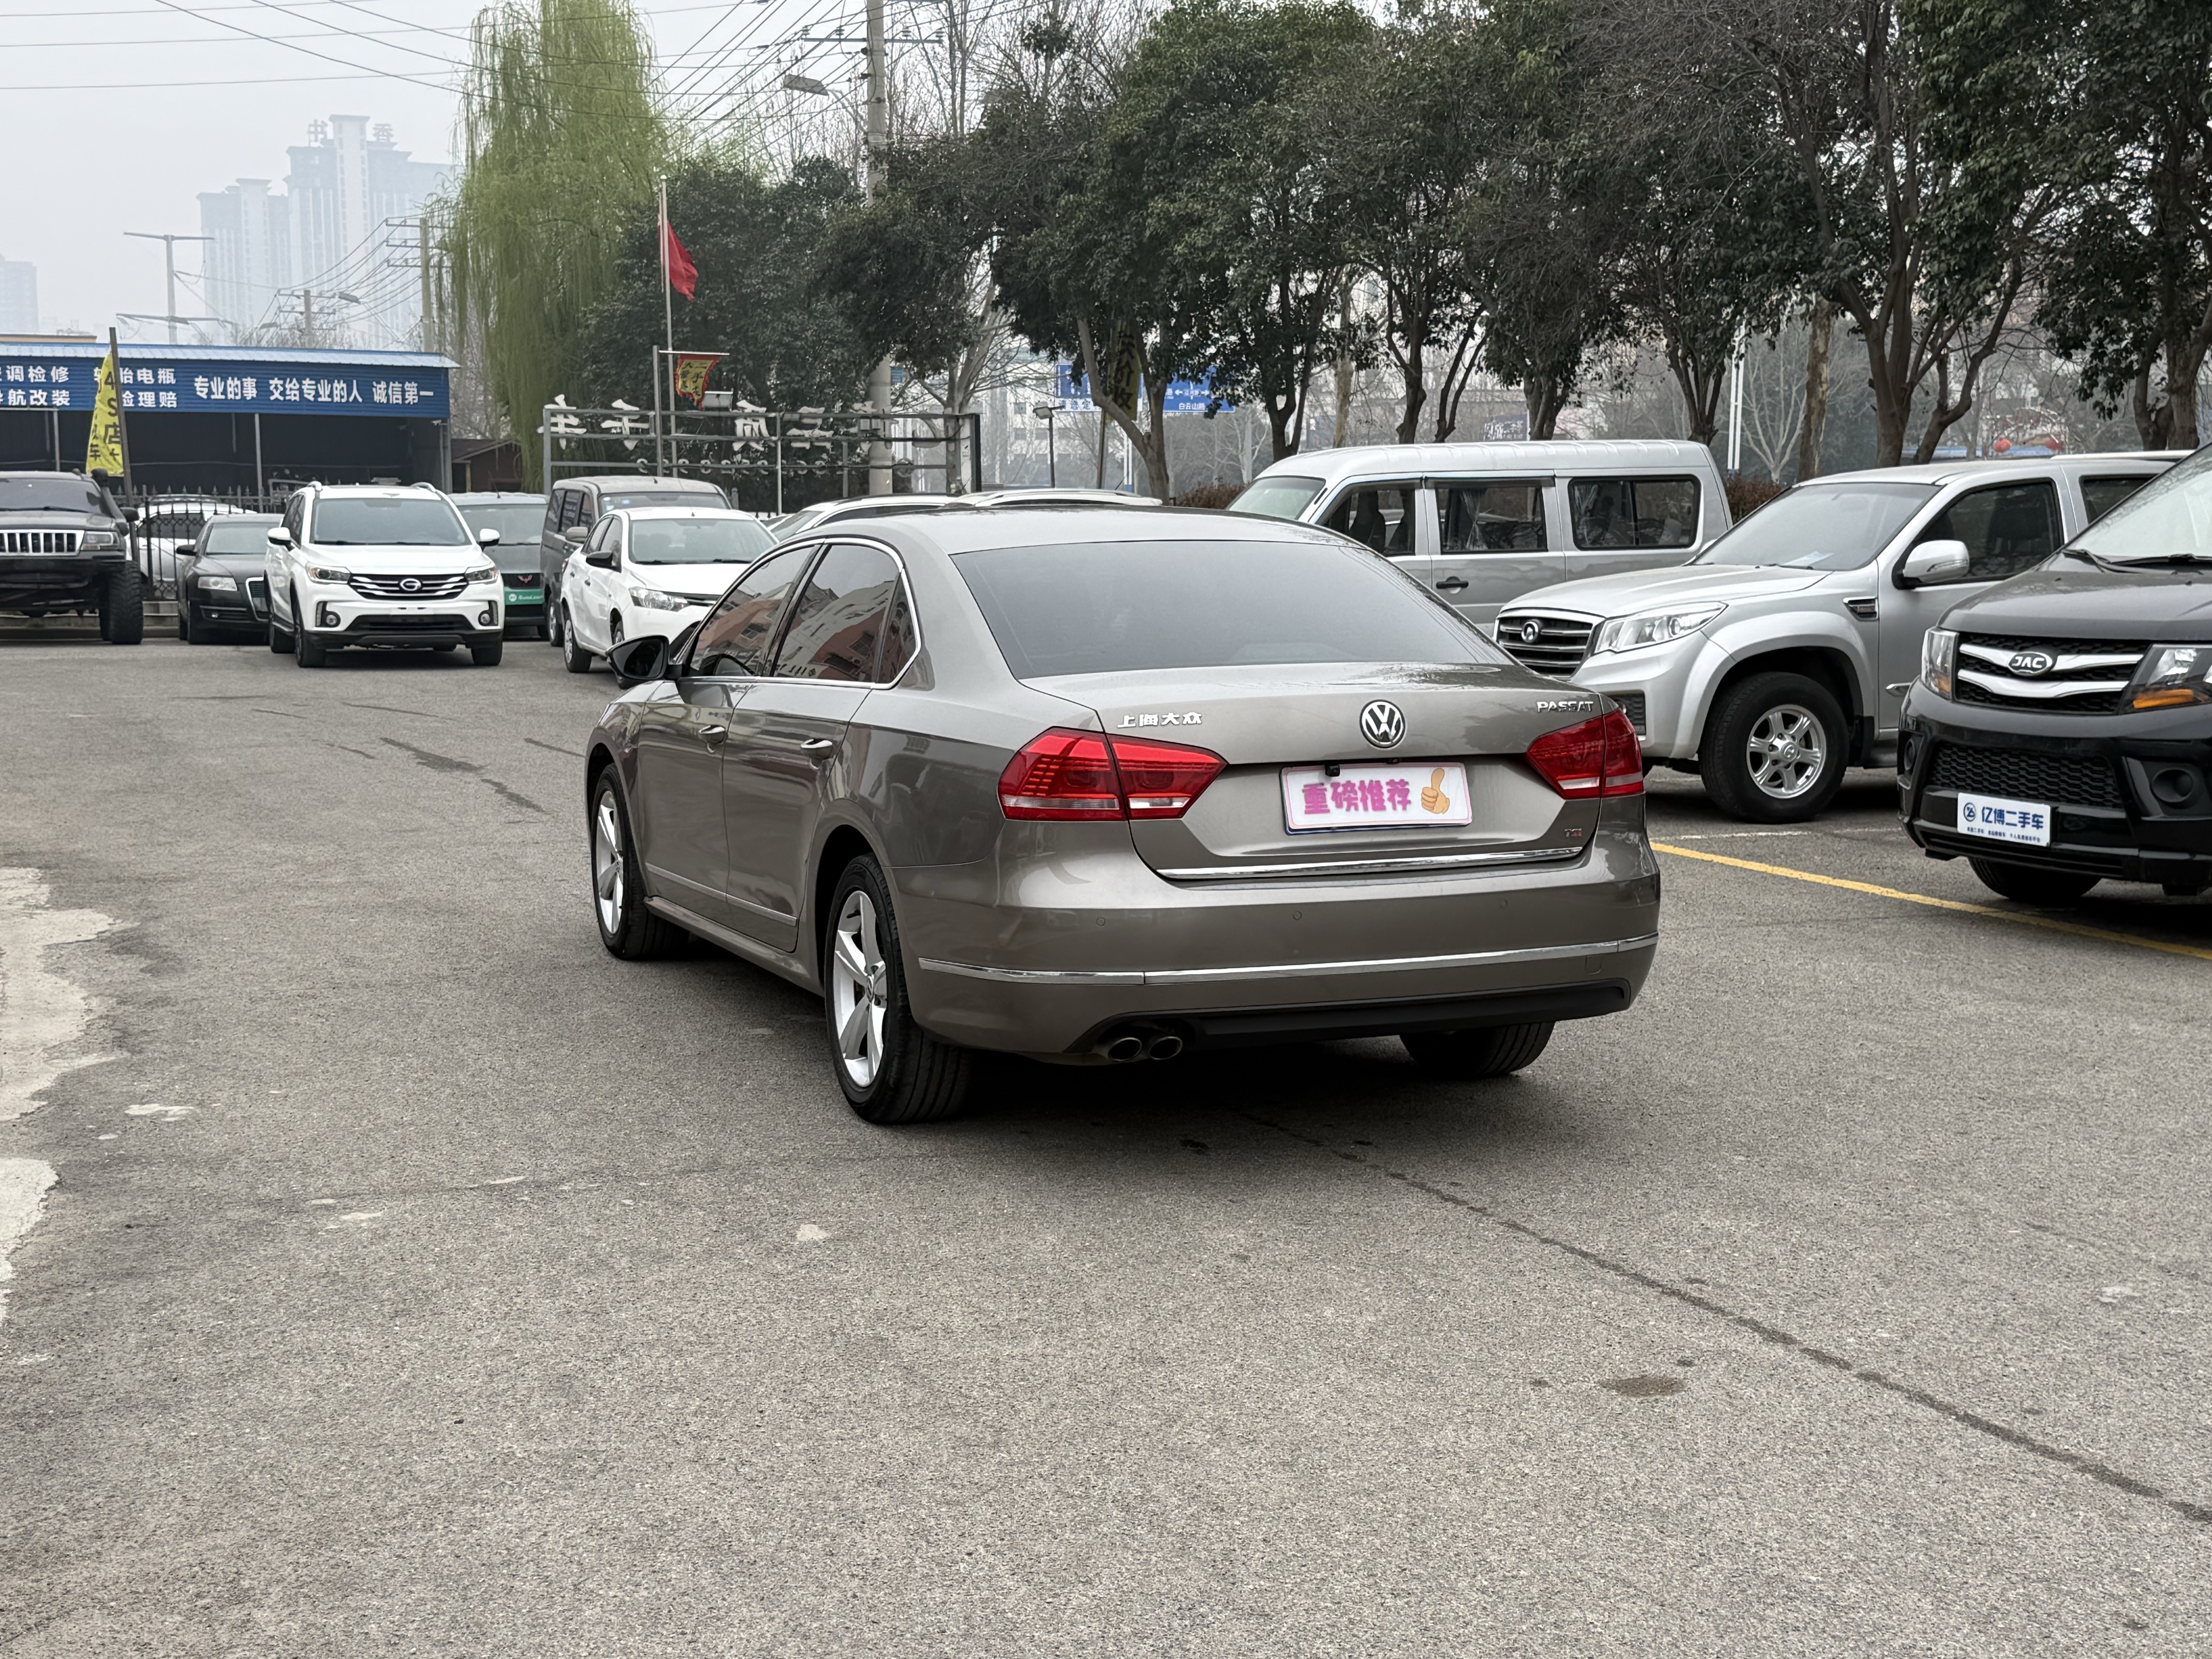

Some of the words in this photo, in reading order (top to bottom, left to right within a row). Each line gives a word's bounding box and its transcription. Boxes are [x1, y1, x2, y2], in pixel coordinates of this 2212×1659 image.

[0, 365, 69, 383] 调检修
[194, 375, 257, 400] 专业的事
[269, 377, 363, 402] 交给专业的人
[373, 381, 434, 405] 诚信第一
[2012, 656, 2045, 668] JAC
[1537, 701, 1594, 713] PASSAT
[1117, 712, 1202, 728] 上海大众
[1302, 779, 1411, 814] 重磅推荐
[1982, 806, 2044, 830] 亿博二手车
